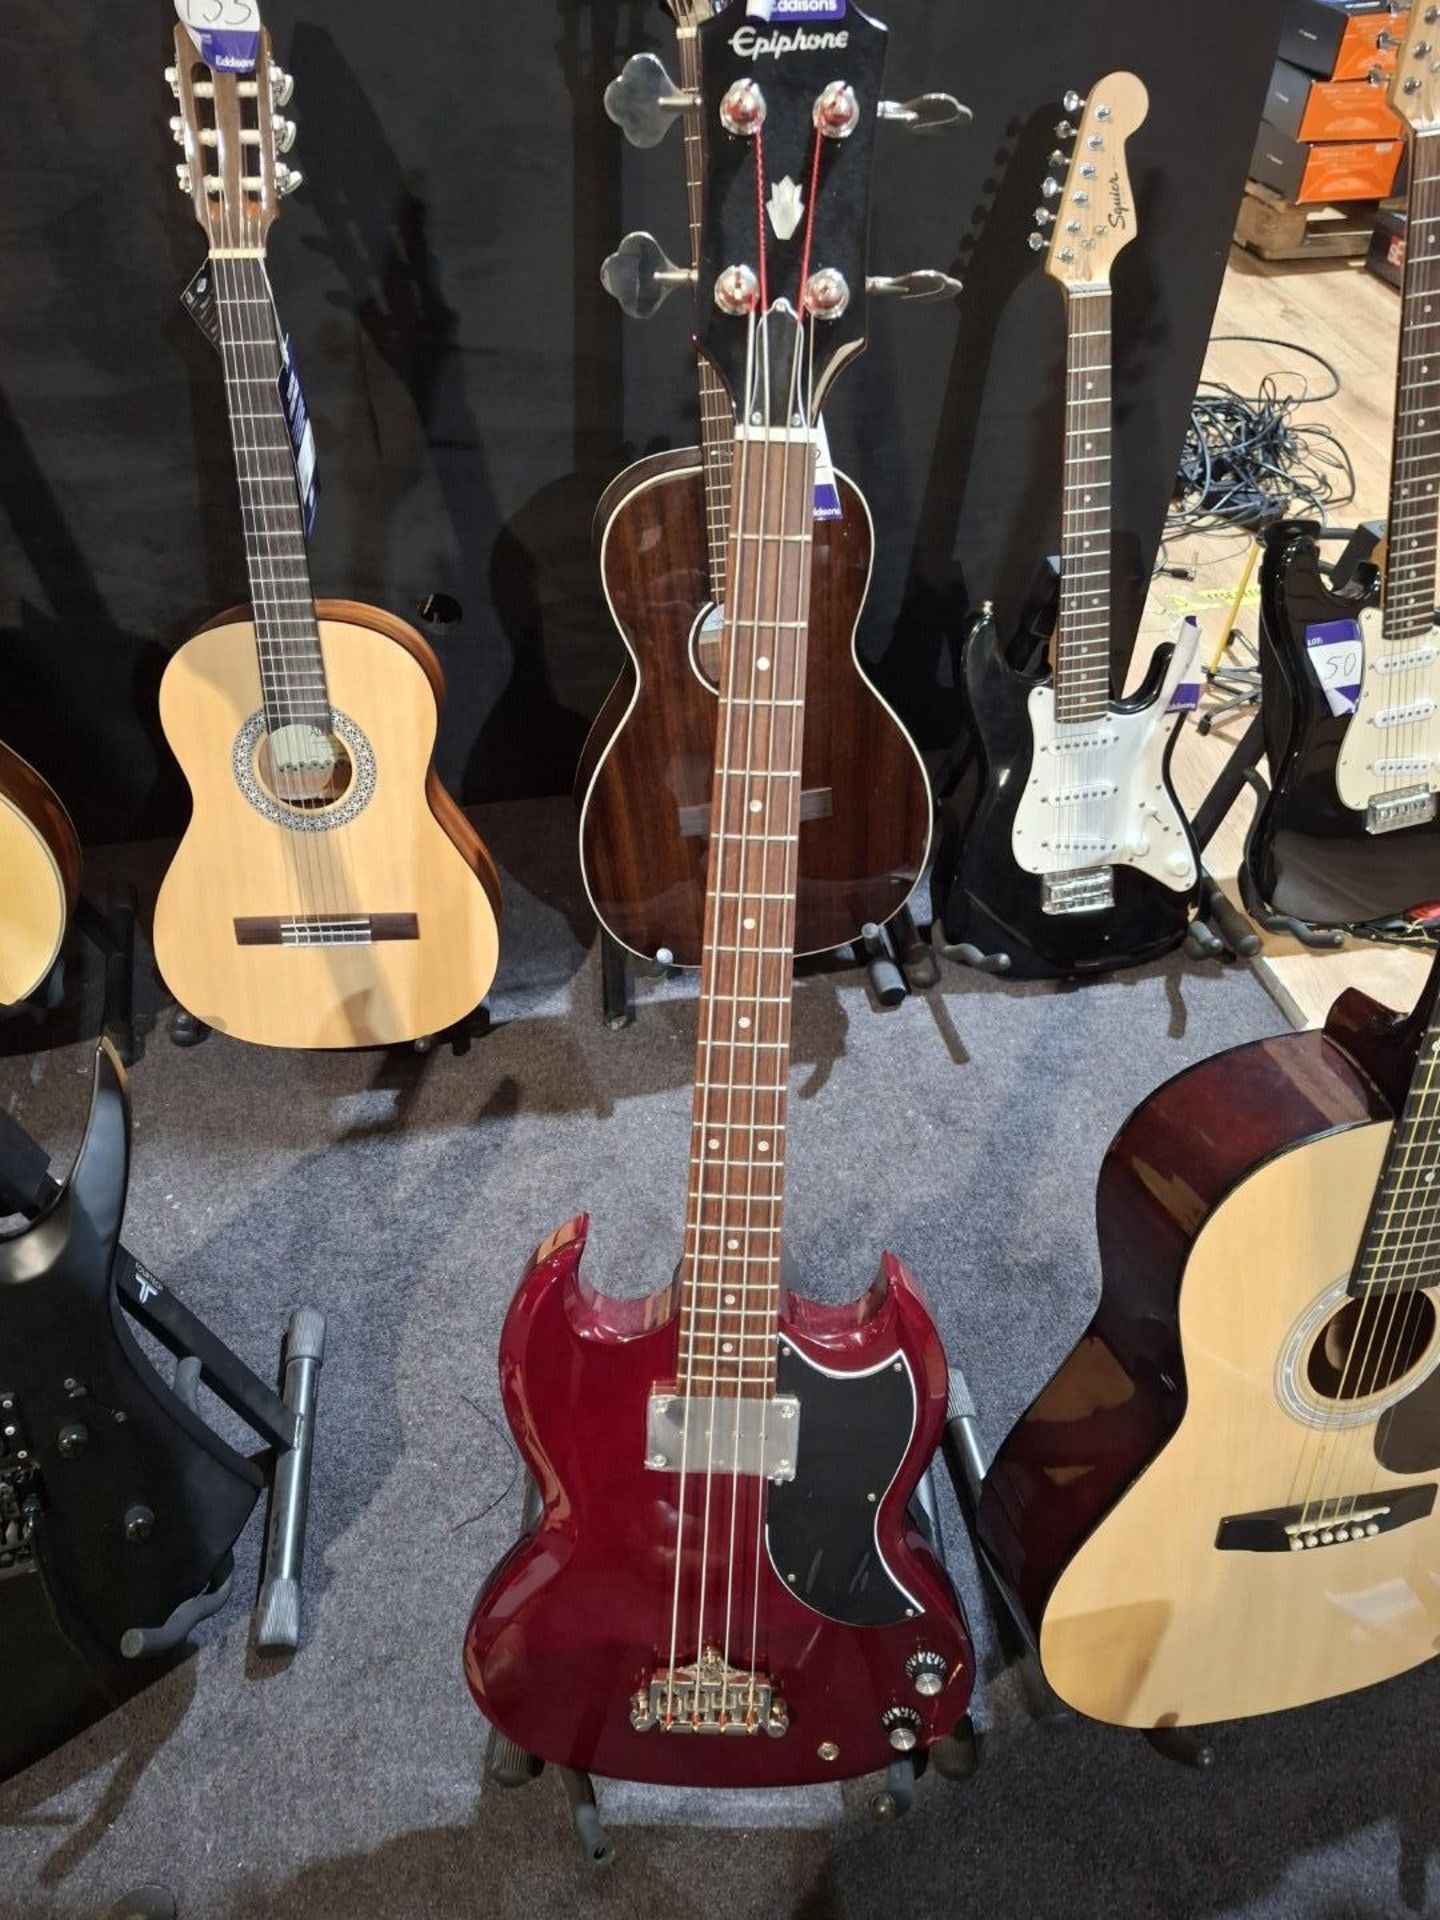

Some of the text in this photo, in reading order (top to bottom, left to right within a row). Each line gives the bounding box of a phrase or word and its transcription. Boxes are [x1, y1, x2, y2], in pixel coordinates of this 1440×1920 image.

[728, 26, 849, 61] Epiphone
[1108, 172, 1129, 230] Squier
[1326, 652, 1357, 680] 50
